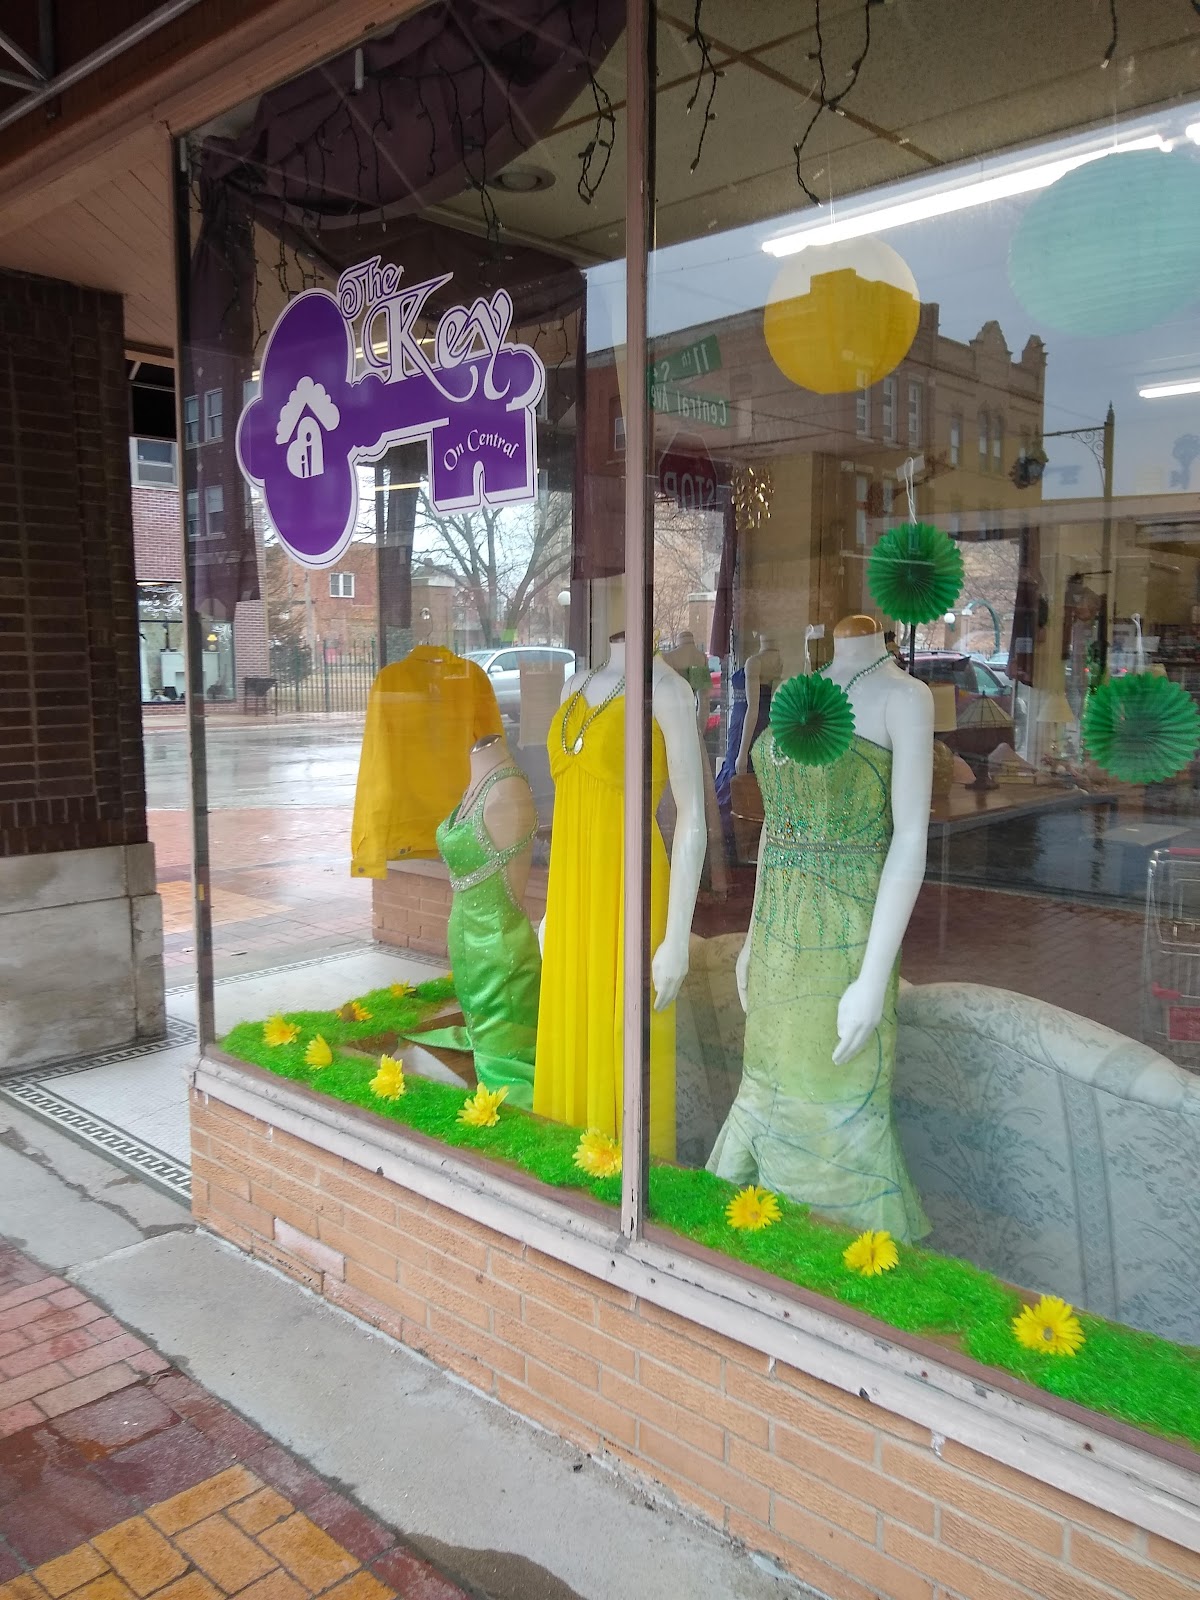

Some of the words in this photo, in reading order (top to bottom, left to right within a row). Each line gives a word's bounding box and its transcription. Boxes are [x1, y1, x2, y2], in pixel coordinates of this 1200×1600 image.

[339, 256, 403, 320] The
[363, 272, 513, 402] Key
[443, 444, 464, 471] On
[467, 429, 519, 459] Central
